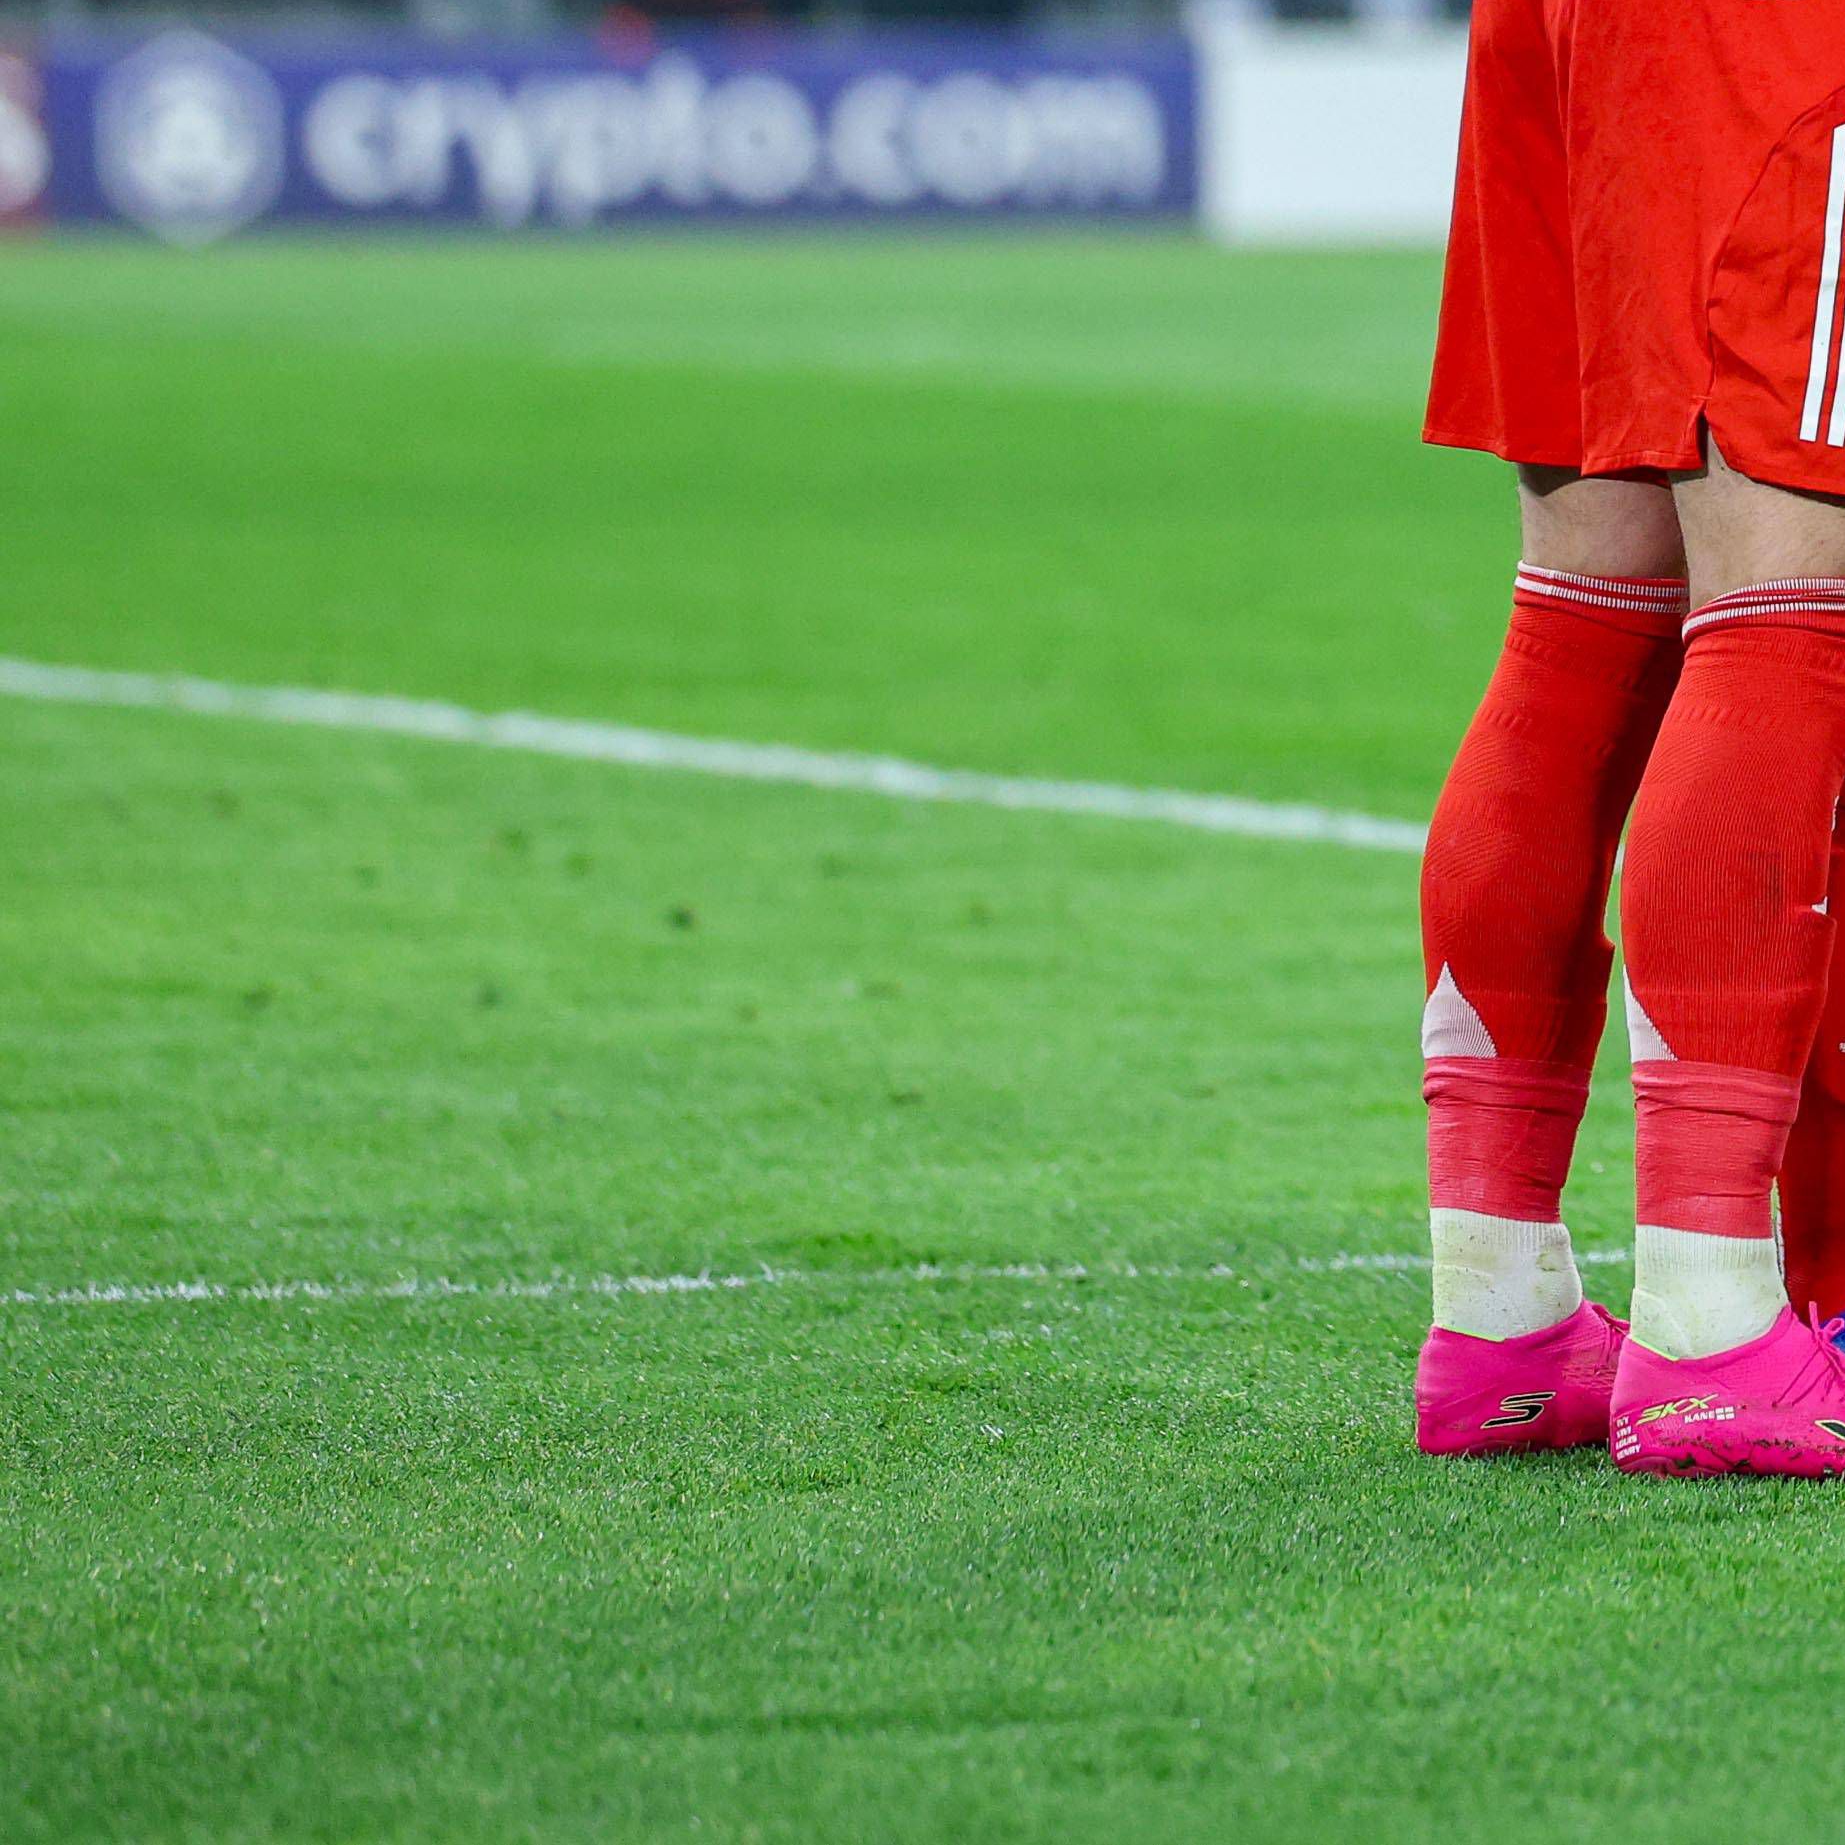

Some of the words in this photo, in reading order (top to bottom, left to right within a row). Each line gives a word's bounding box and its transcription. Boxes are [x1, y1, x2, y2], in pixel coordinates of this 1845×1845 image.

[303, 49, 1166, 229] crypto.com
[1636, 1393, 1719, 1427] SKX
[1684, 1411, 1715, 1424] KANE
